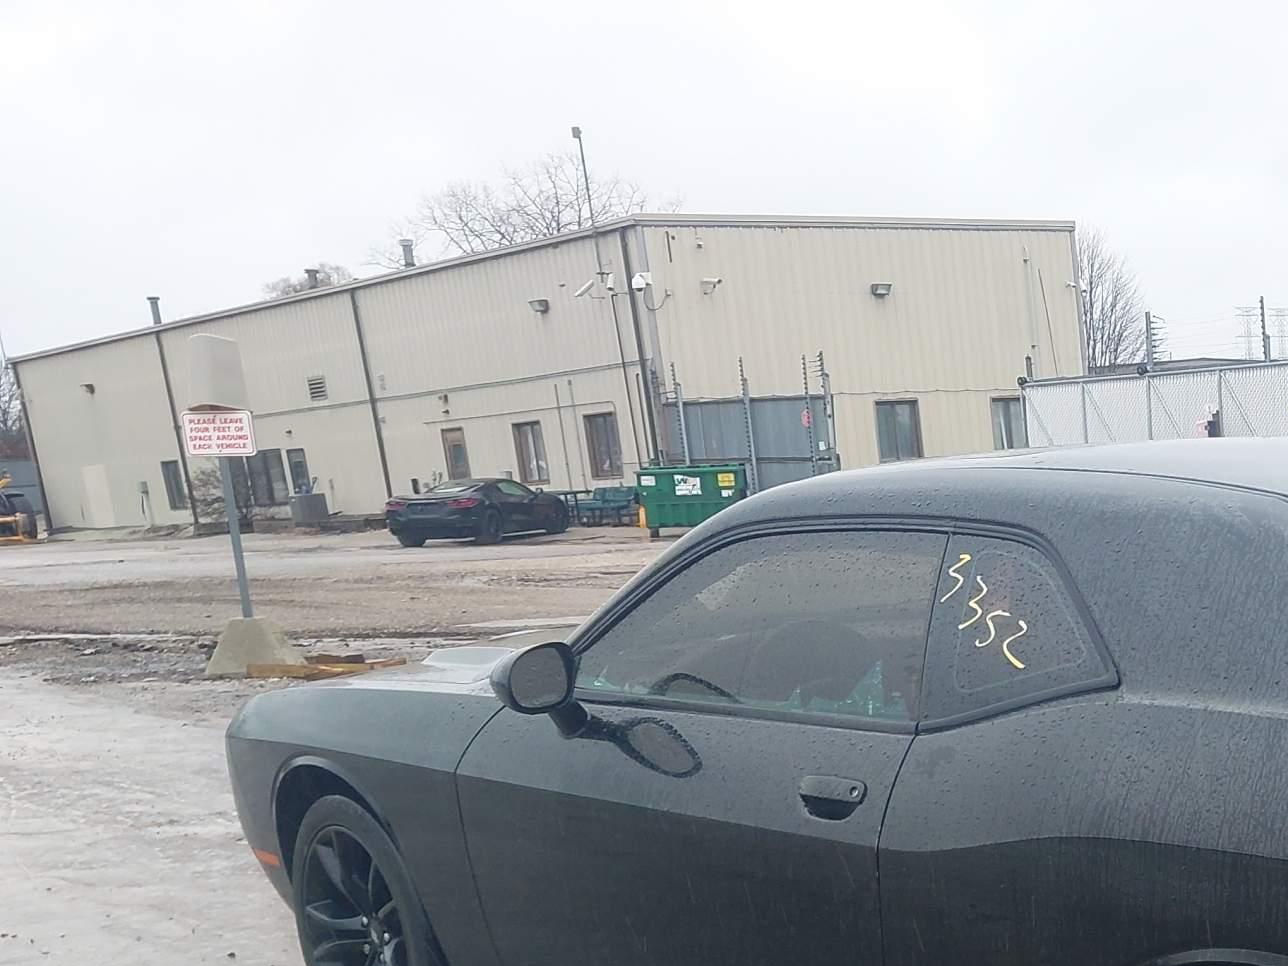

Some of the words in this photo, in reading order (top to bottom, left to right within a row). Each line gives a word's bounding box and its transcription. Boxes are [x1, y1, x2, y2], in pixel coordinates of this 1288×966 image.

[188, 417, 216, 425] PLEASE
[219, 417, 243, 425] LEAVE
[189, 434, 212, 442] SPACE
[940, 553, 1028, 669] 3352
